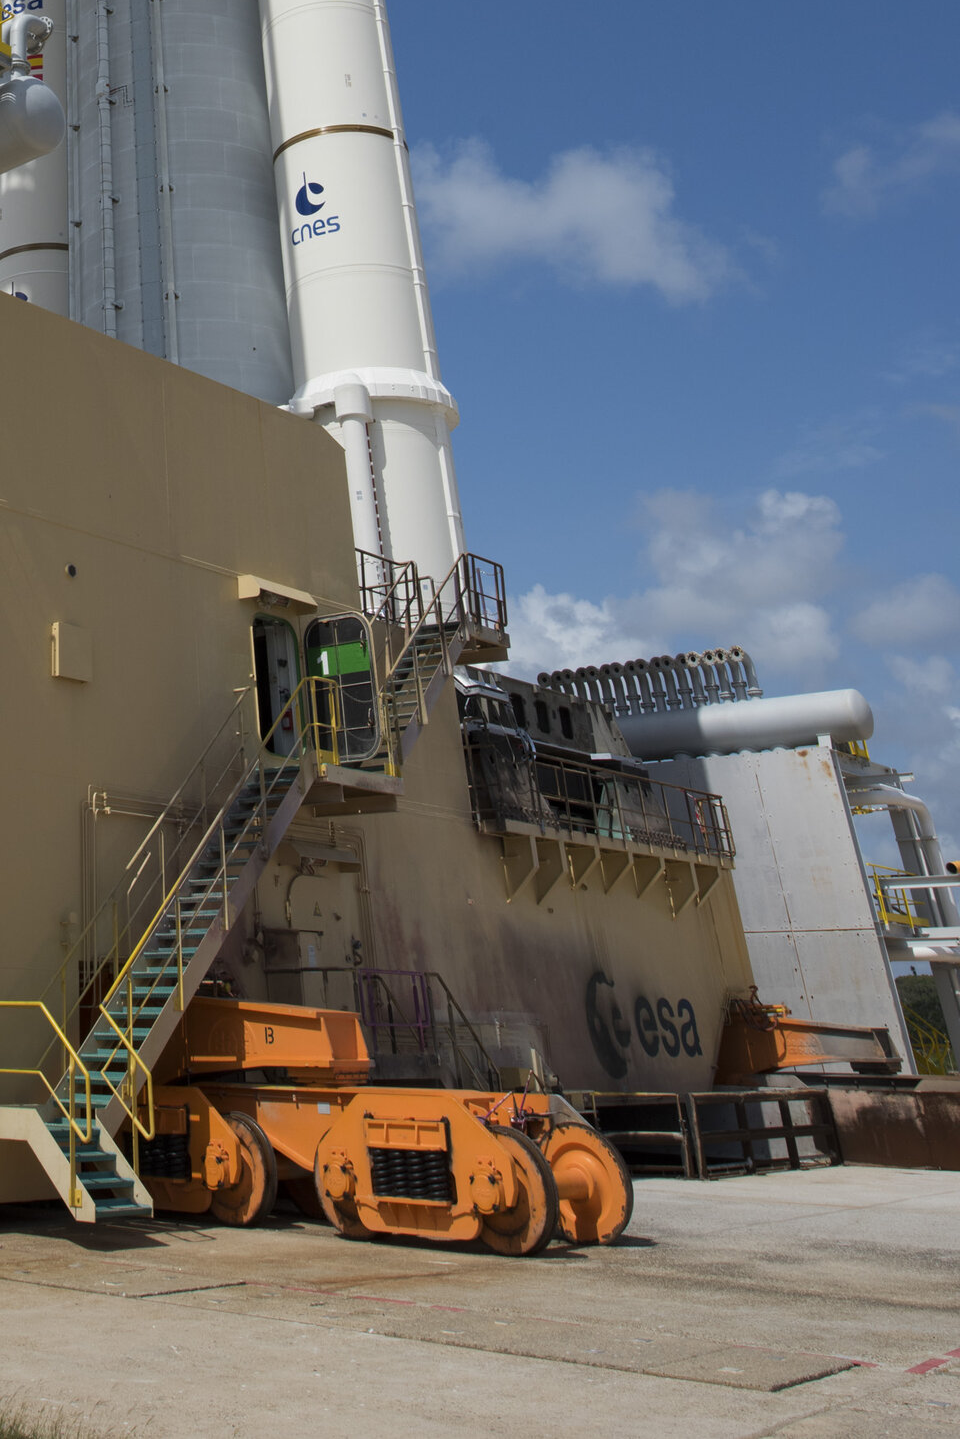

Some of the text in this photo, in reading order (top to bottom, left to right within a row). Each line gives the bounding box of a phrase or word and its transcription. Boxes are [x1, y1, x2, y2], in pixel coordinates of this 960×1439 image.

[291, 215, 341, 246] cnes
[316, 650, 330, 676] 1
[634, 996, 703, 1058] esa
